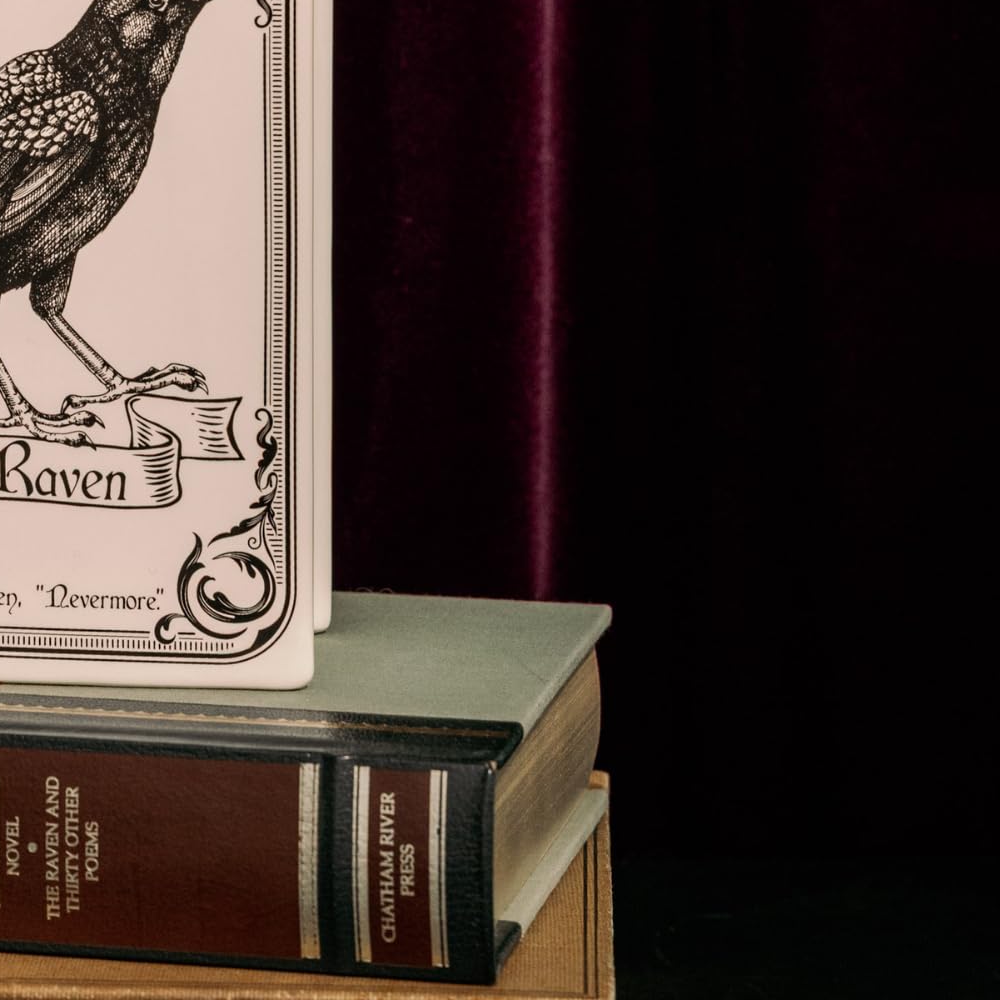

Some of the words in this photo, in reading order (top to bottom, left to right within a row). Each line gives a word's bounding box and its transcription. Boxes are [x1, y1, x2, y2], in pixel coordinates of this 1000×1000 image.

[45, 775, 60, 818] AND
[65, 786, 80, 848] OTHER
[380, 792, 396, 846] RIVER
[5, 815, 21, 877] NOVEL
[45, 822, 60, 882] RAVEN
[84, 820, 100, 882] POEMS
[400, 843, 415, 896] PRESS
[46, 883, 61, 921] THE
[65, 851, 80, 914] THIRTY
[380, 850, 396, 944] CHATHAM
